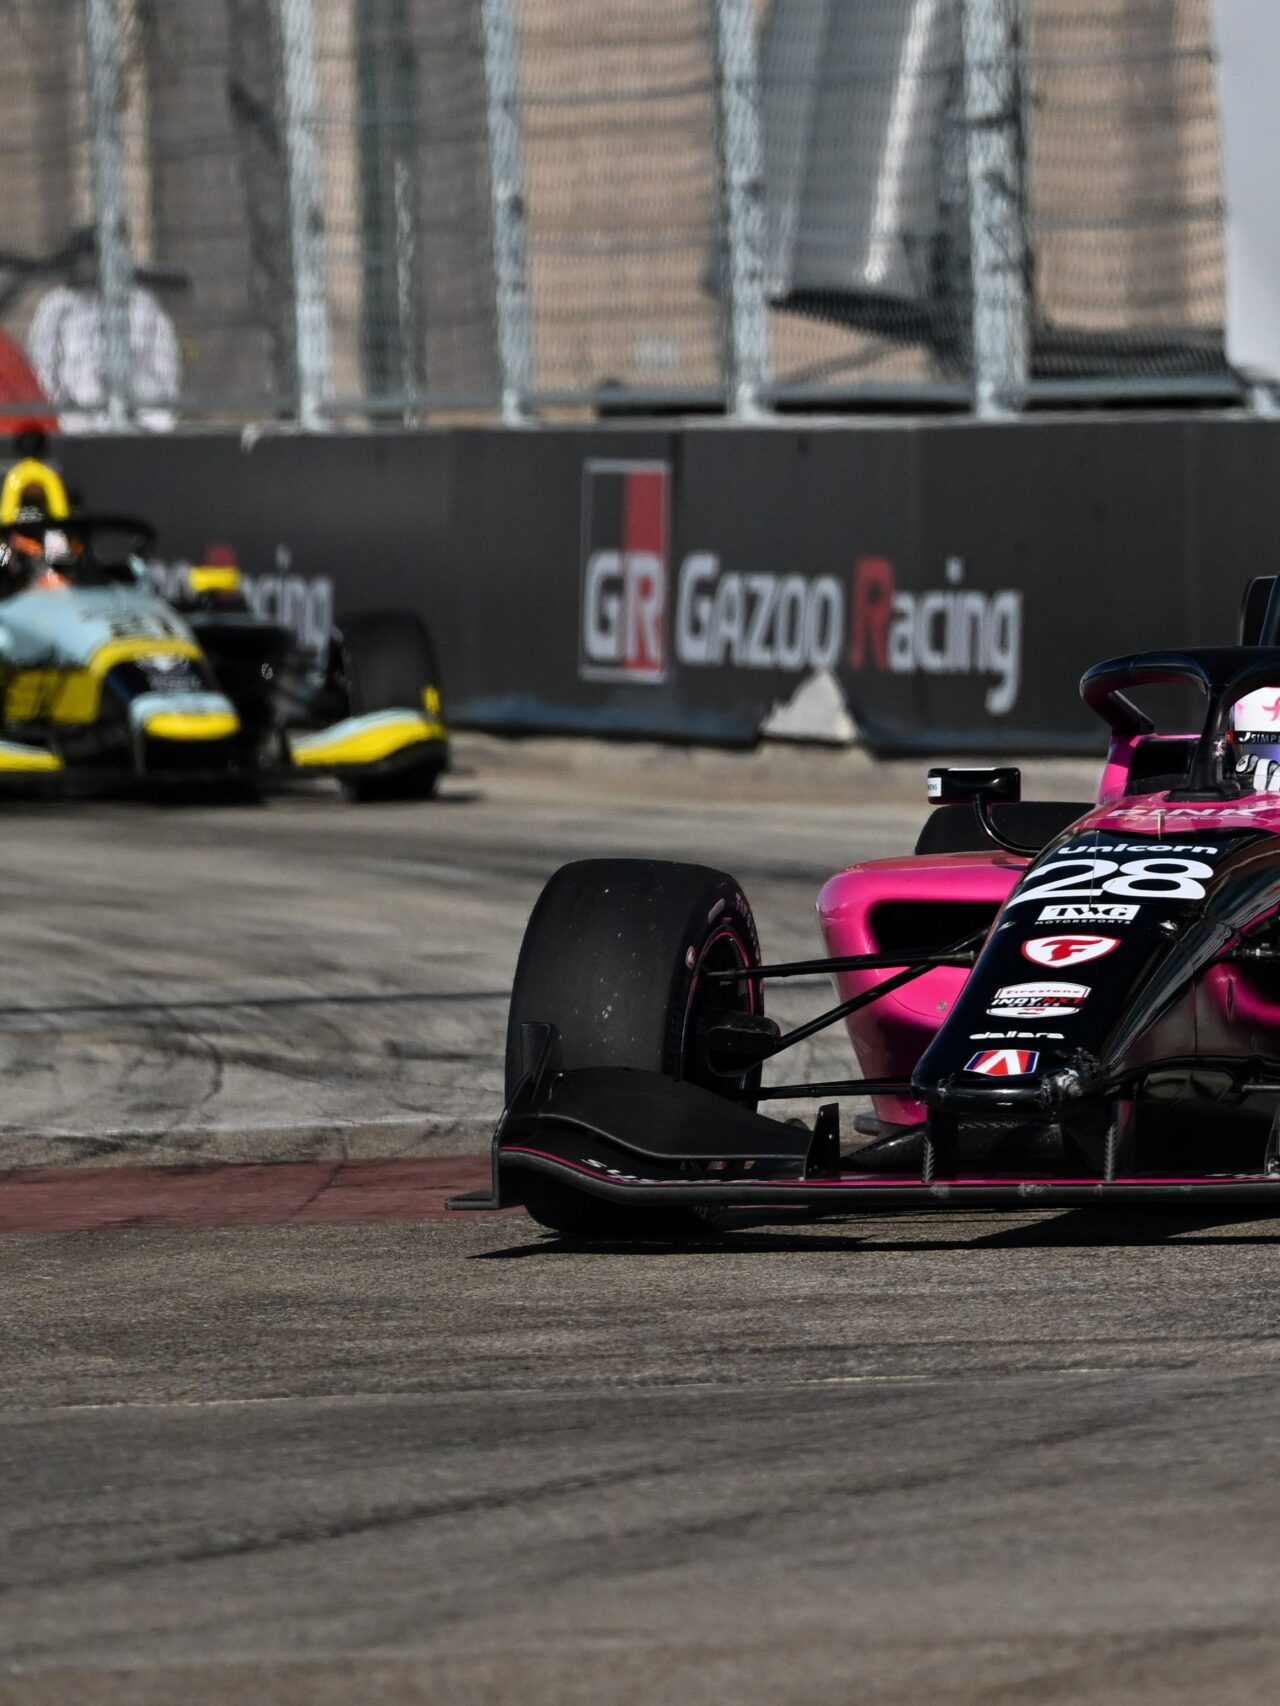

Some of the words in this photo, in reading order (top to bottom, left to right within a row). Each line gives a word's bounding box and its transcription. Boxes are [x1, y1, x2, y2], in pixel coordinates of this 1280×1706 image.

[584, 551, 665, 663] GR
[849, 554, 1022, 715] Racing
[1105, 808, 1256, 817] PINK
[1057, 843, 1218, 855] unicorn
[1005, 858, 1214, 909] 28
[1048, 905, 1130, 918] TWG
[969, 1031, 1064, 1040] dallara
